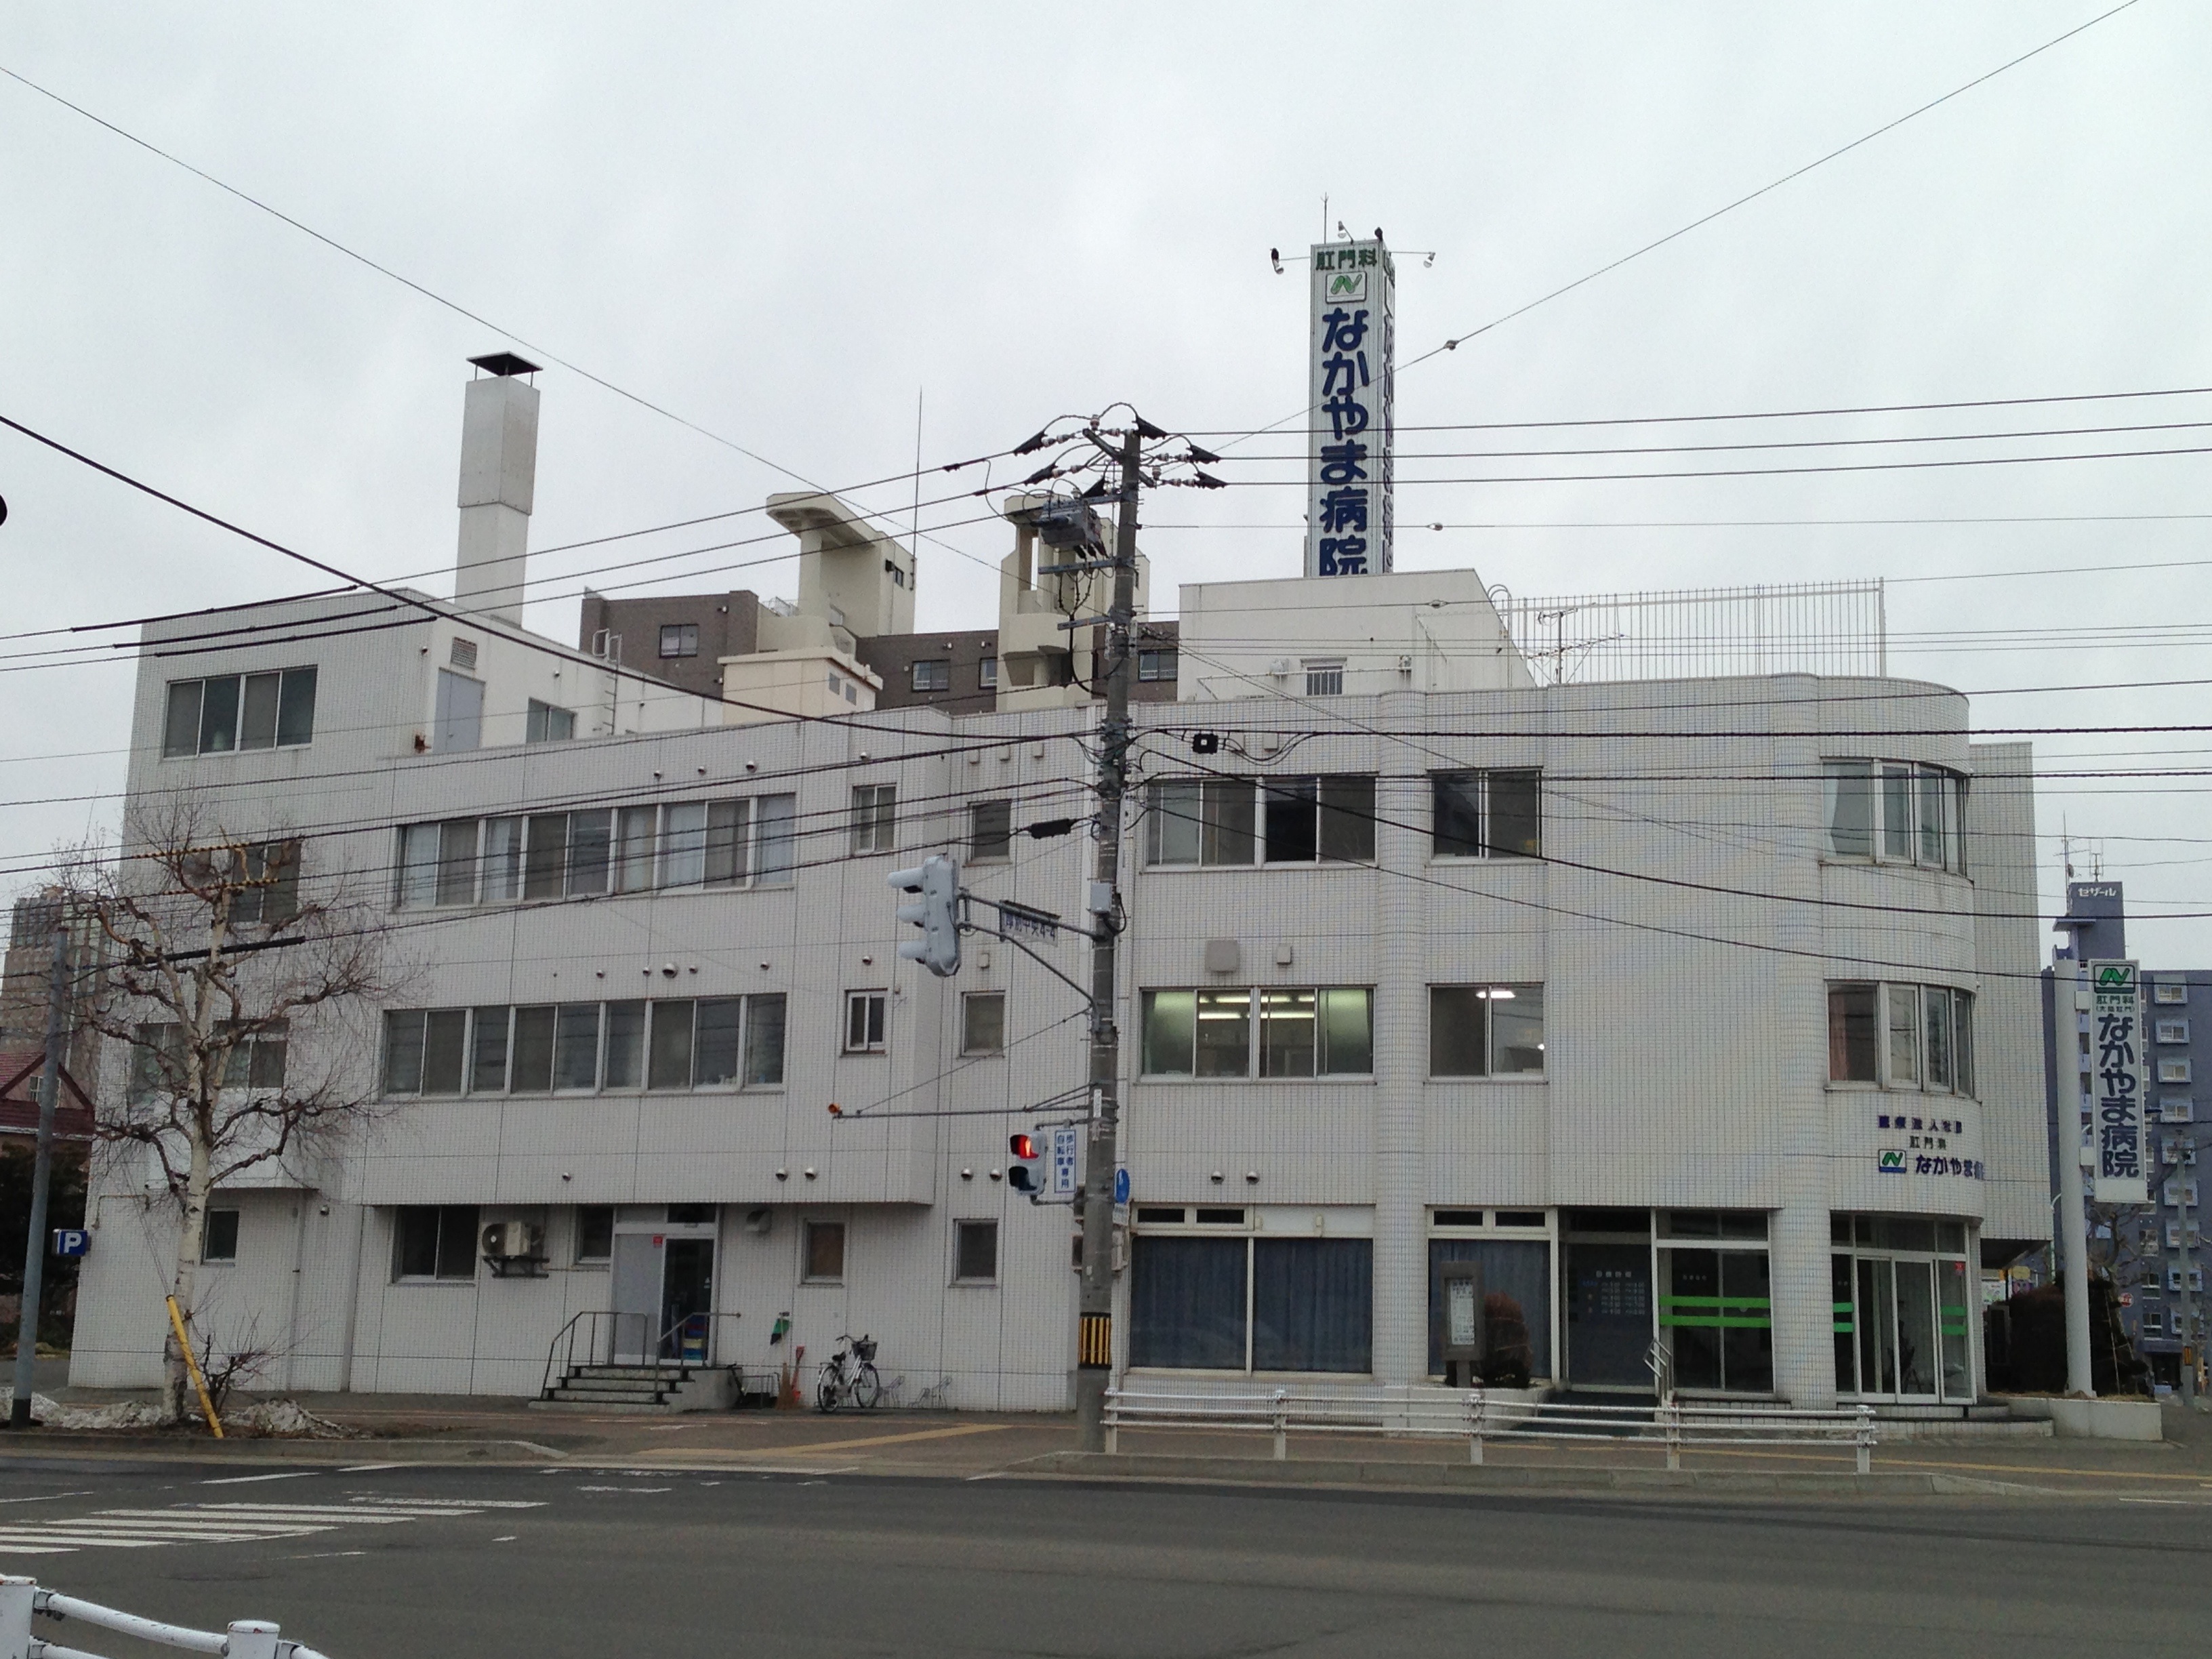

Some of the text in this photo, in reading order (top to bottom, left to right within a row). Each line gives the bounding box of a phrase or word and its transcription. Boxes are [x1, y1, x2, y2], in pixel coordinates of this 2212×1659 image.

[1316, 247, 1377, 270] 肛門科
[1320, 308, 1368, 576] なかやま病院
[2097, 1013, 2139, 1178] なかやま病院
[64, 1232, 82, 1253] P
